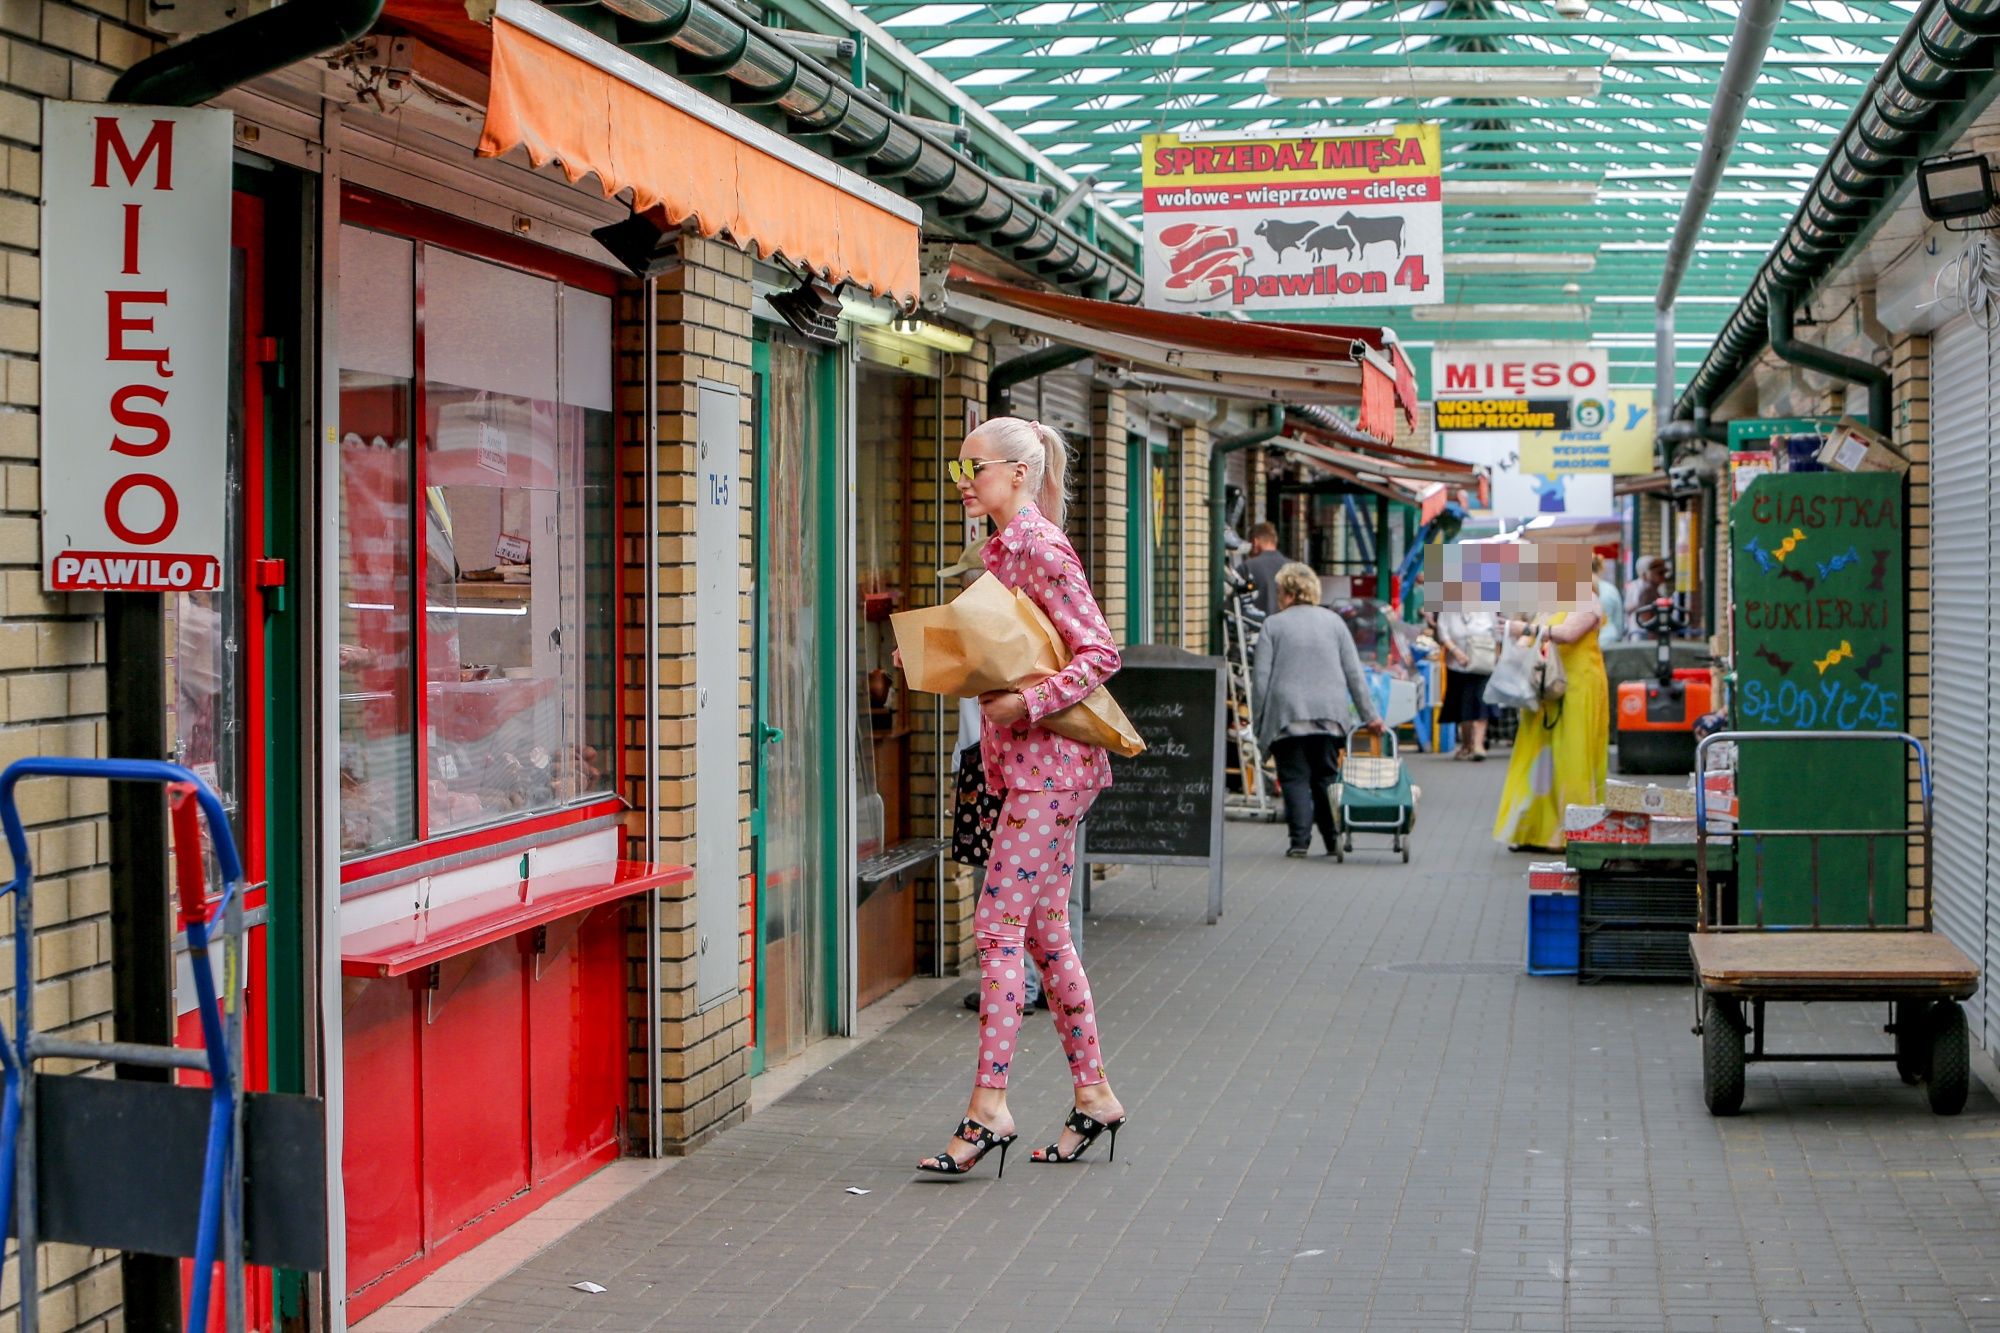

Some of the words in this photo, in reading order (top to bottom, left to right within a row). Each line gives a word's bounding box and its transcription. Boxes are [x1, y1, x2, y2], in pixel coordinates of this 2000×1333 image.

[1154, 137, 1318, 176] SPRZEDAŻ
[1322, 137, 1426, 173] MIĘSA
[1157, 187, 1229, 207] wołowe
[1246, 186, 1347, 208] wieprzowe
[1363, 180, 1427, 202] cielęce
[1232, 264, 1387, 305] pawilon
[1394, 254, 1430, 292] 4
[91, 116, 179, 546] MIĘSO
[1445, 361, 1597, 395] MIĘSO
[1437, 400, 1529, 414] WOŁOWE
[1437, 413, 1555, 428] WIEPRZOWE
[709, 473, 728, 506] TL-5
[1751, 487, 1899, 529] CIASTKA
[1744, 598, 1889, 631] CUKIERKI
[1742, 680, 1899, 730] SŁODYCZE
